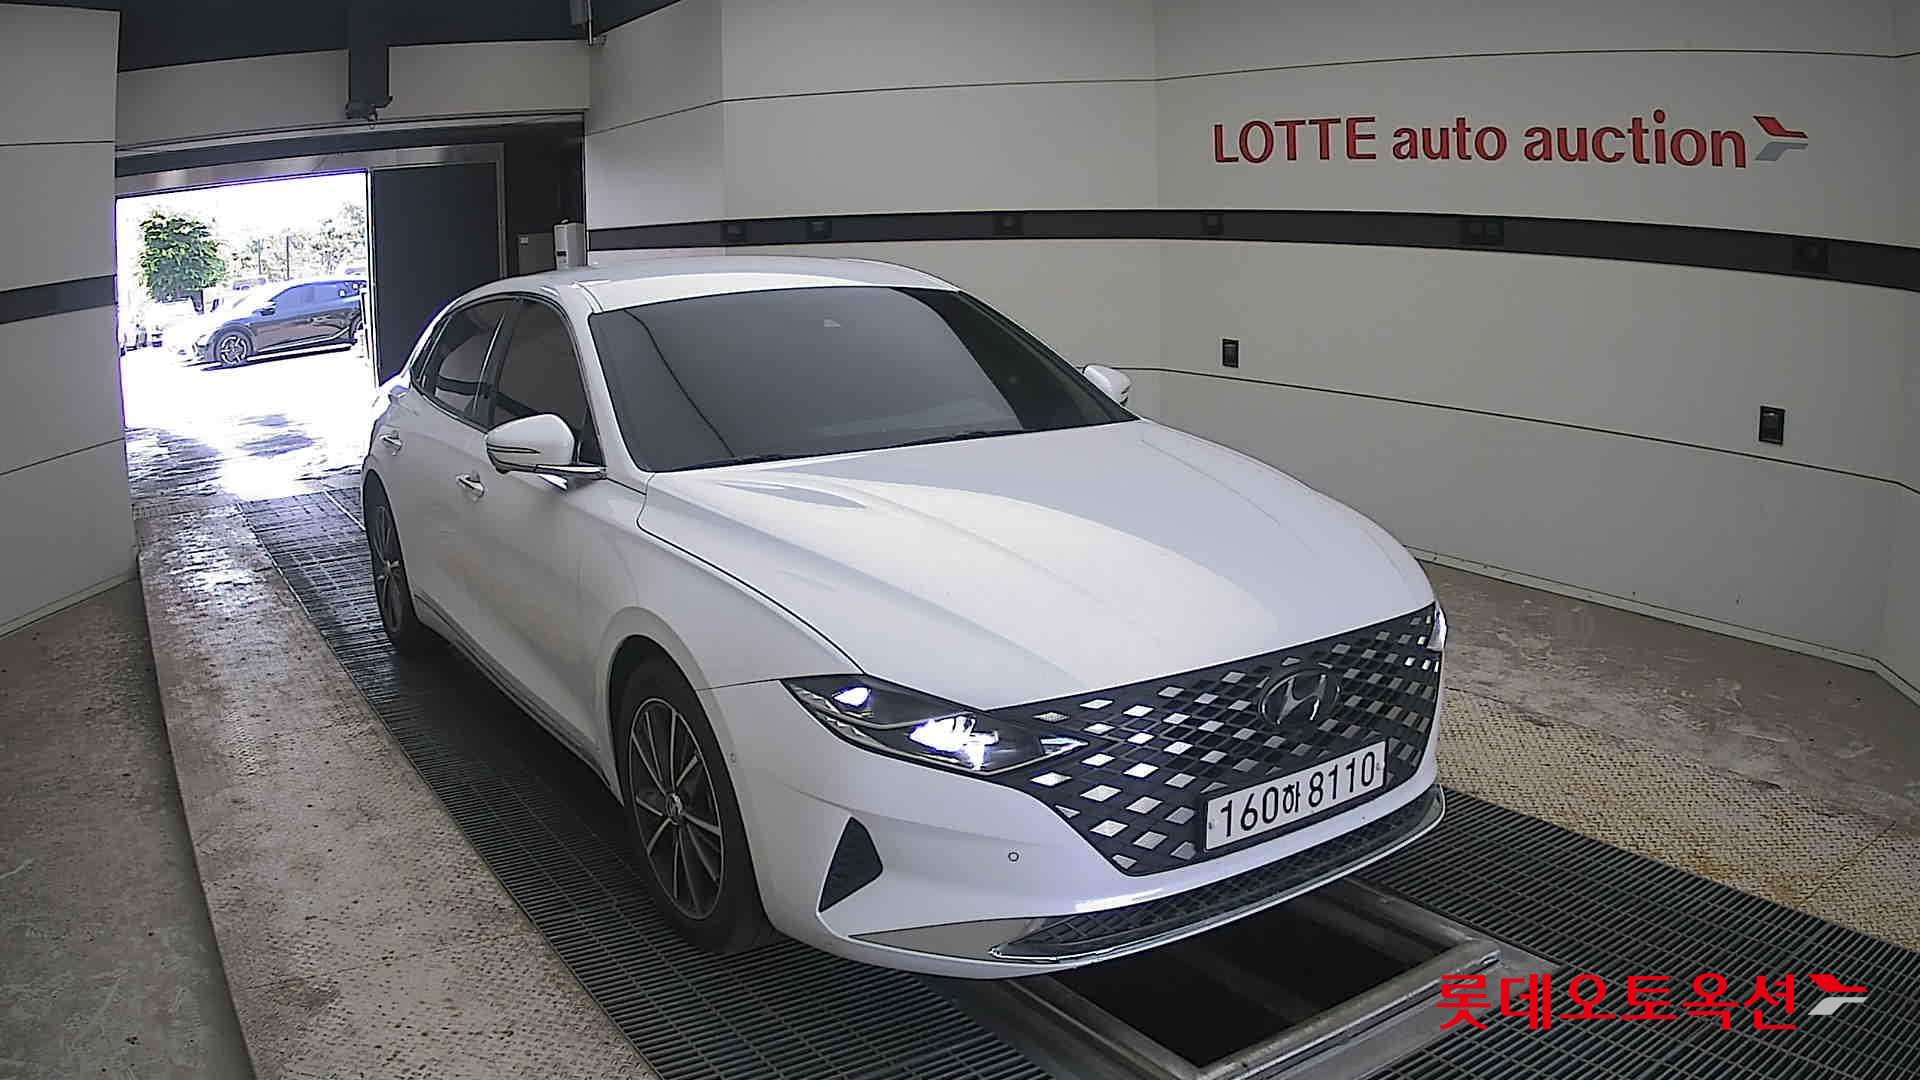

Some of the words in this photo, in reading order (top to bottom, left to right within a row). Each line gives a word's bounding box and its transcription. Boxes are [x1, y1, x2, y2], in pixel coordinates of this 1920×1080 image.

[1213, 116, 1377, 164] LOTTE
[1392, 116, 1508, 163] auto
[1523, 109, 1747, 169] auction
[1220, 781, 1300, 837] 160하
[1308, 751, 1375, 808] 8110
